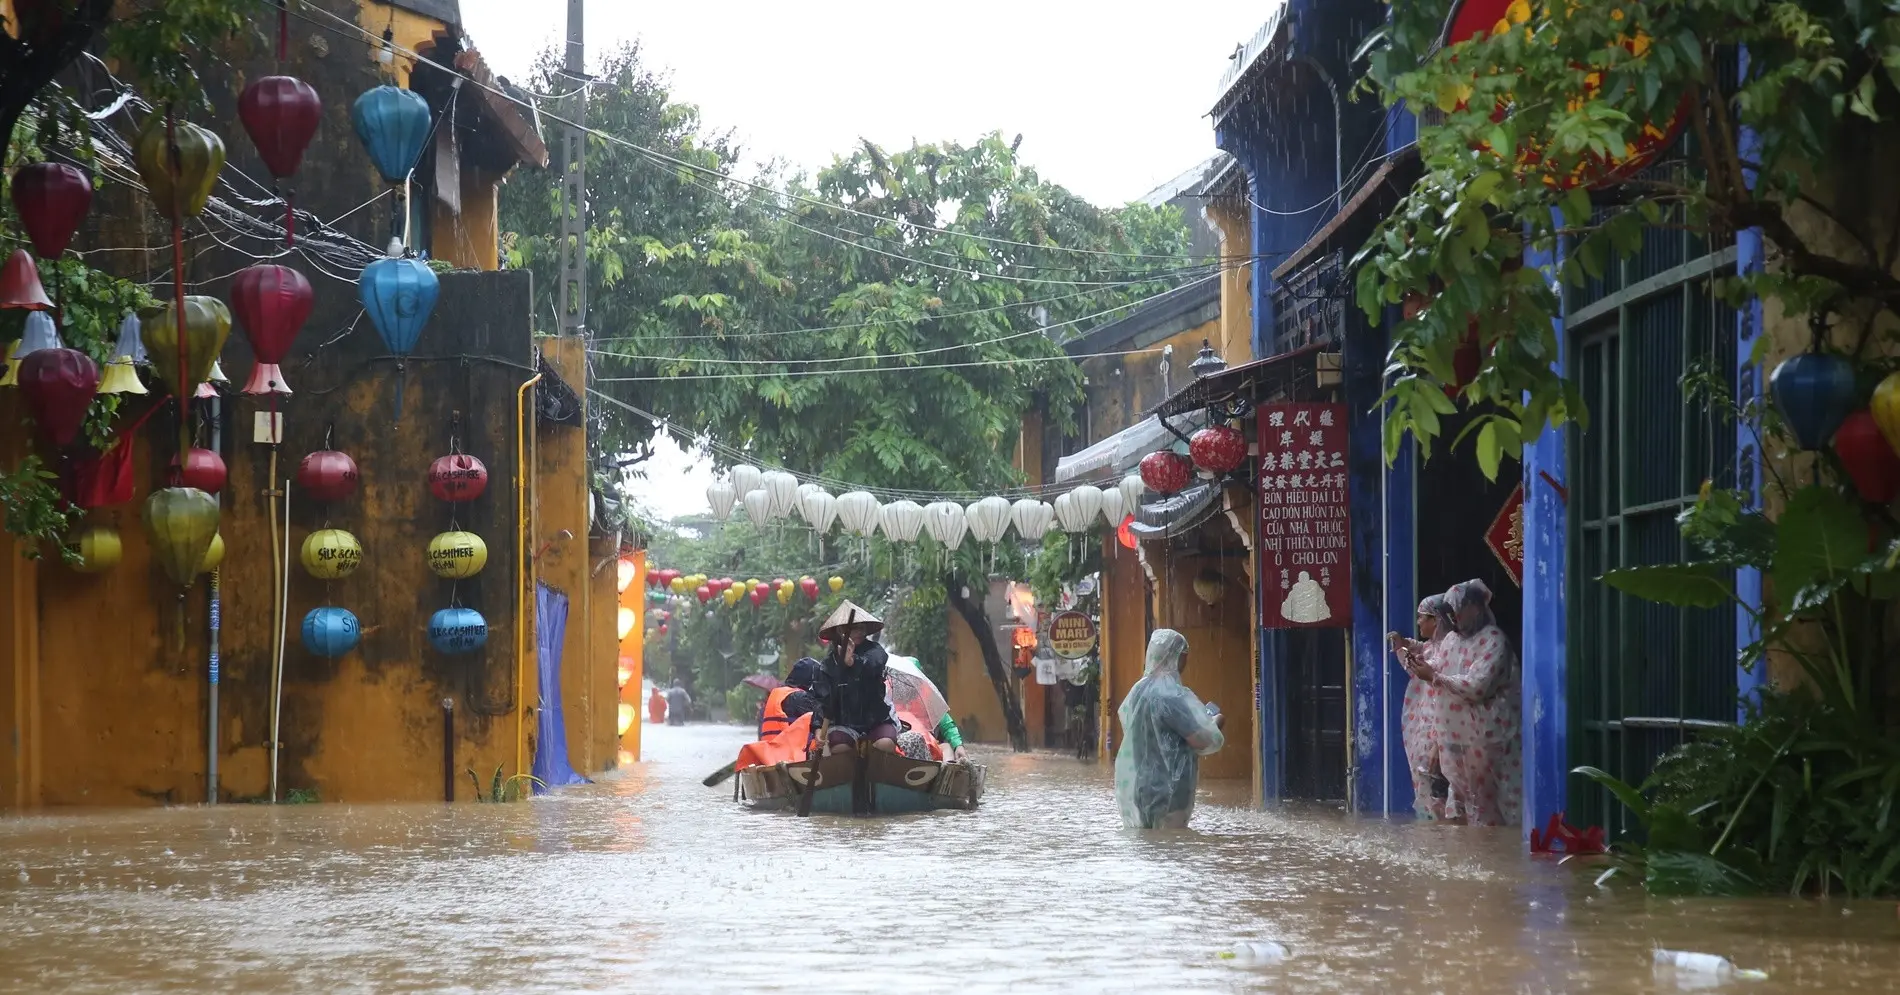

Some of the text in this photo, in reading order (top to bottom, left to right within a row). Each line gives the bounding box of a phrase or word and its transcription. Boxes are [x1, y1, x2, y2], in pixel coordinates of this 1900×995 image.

[1262, 507, 1280, 519] CAO
[1292, 551, 1338, 565] CHOLON
[1058, 617, 1086, 628] MINI
[1056, 628, 1089, 639] MART
